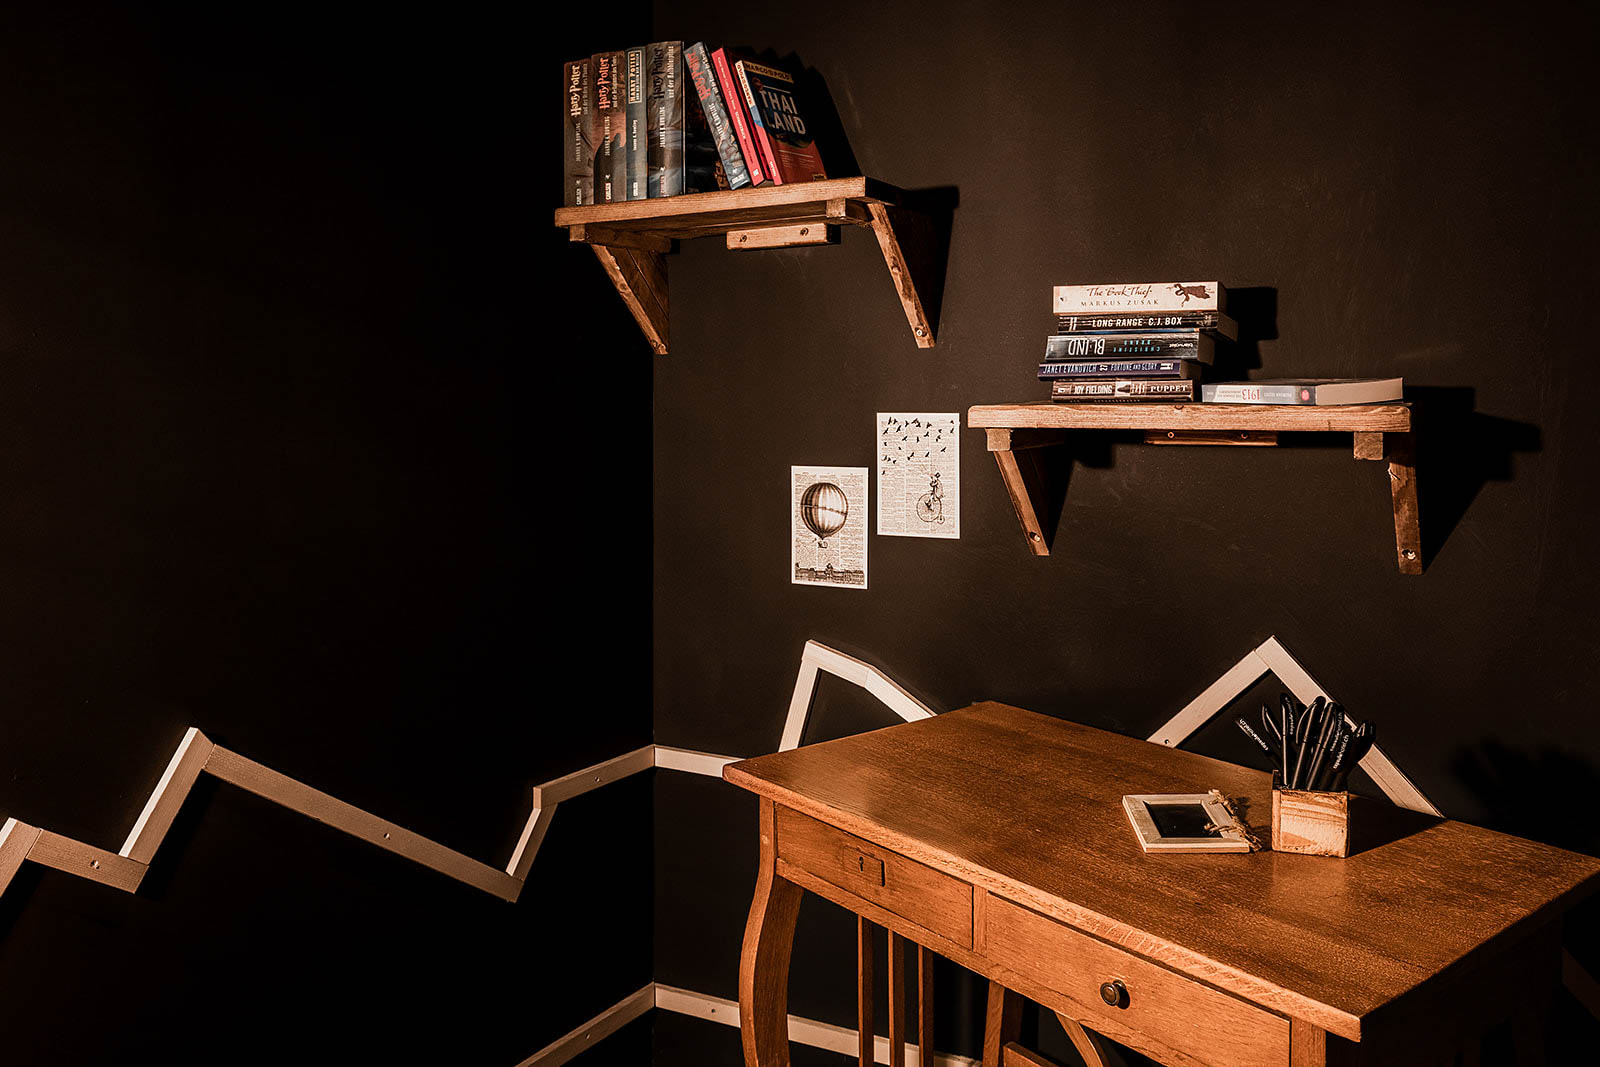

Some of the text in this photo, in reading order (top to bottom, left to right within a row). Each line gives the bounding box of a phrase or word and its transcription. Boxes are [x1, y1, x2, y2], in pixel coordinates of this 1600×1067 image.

[651, 47, 665, 99] Harry Potter
[687, 50, 711, 101] Harry Potter
[569, 65, 581, 117] Harry Potter
[597, 57, 611, 109] Harry Potter
[760, 90, 798, 115] THAI
[764, 110, 806, 135] LAND
[1087, 285, 1153, 298] The Book Thief
[1092, 319, 1113, 328] LONG
[1115, 318, 1143, 327] RANGE
[1165, 317, 1182, 325] BOX
[1043, 364, 1097, 374] JANET EVANOVICH
[1074, 384, 1113, 394] JOY FIELDING
[1150, 384, 1188, 393] PUPPET
[1241, 388, 1261, 401] 1913
